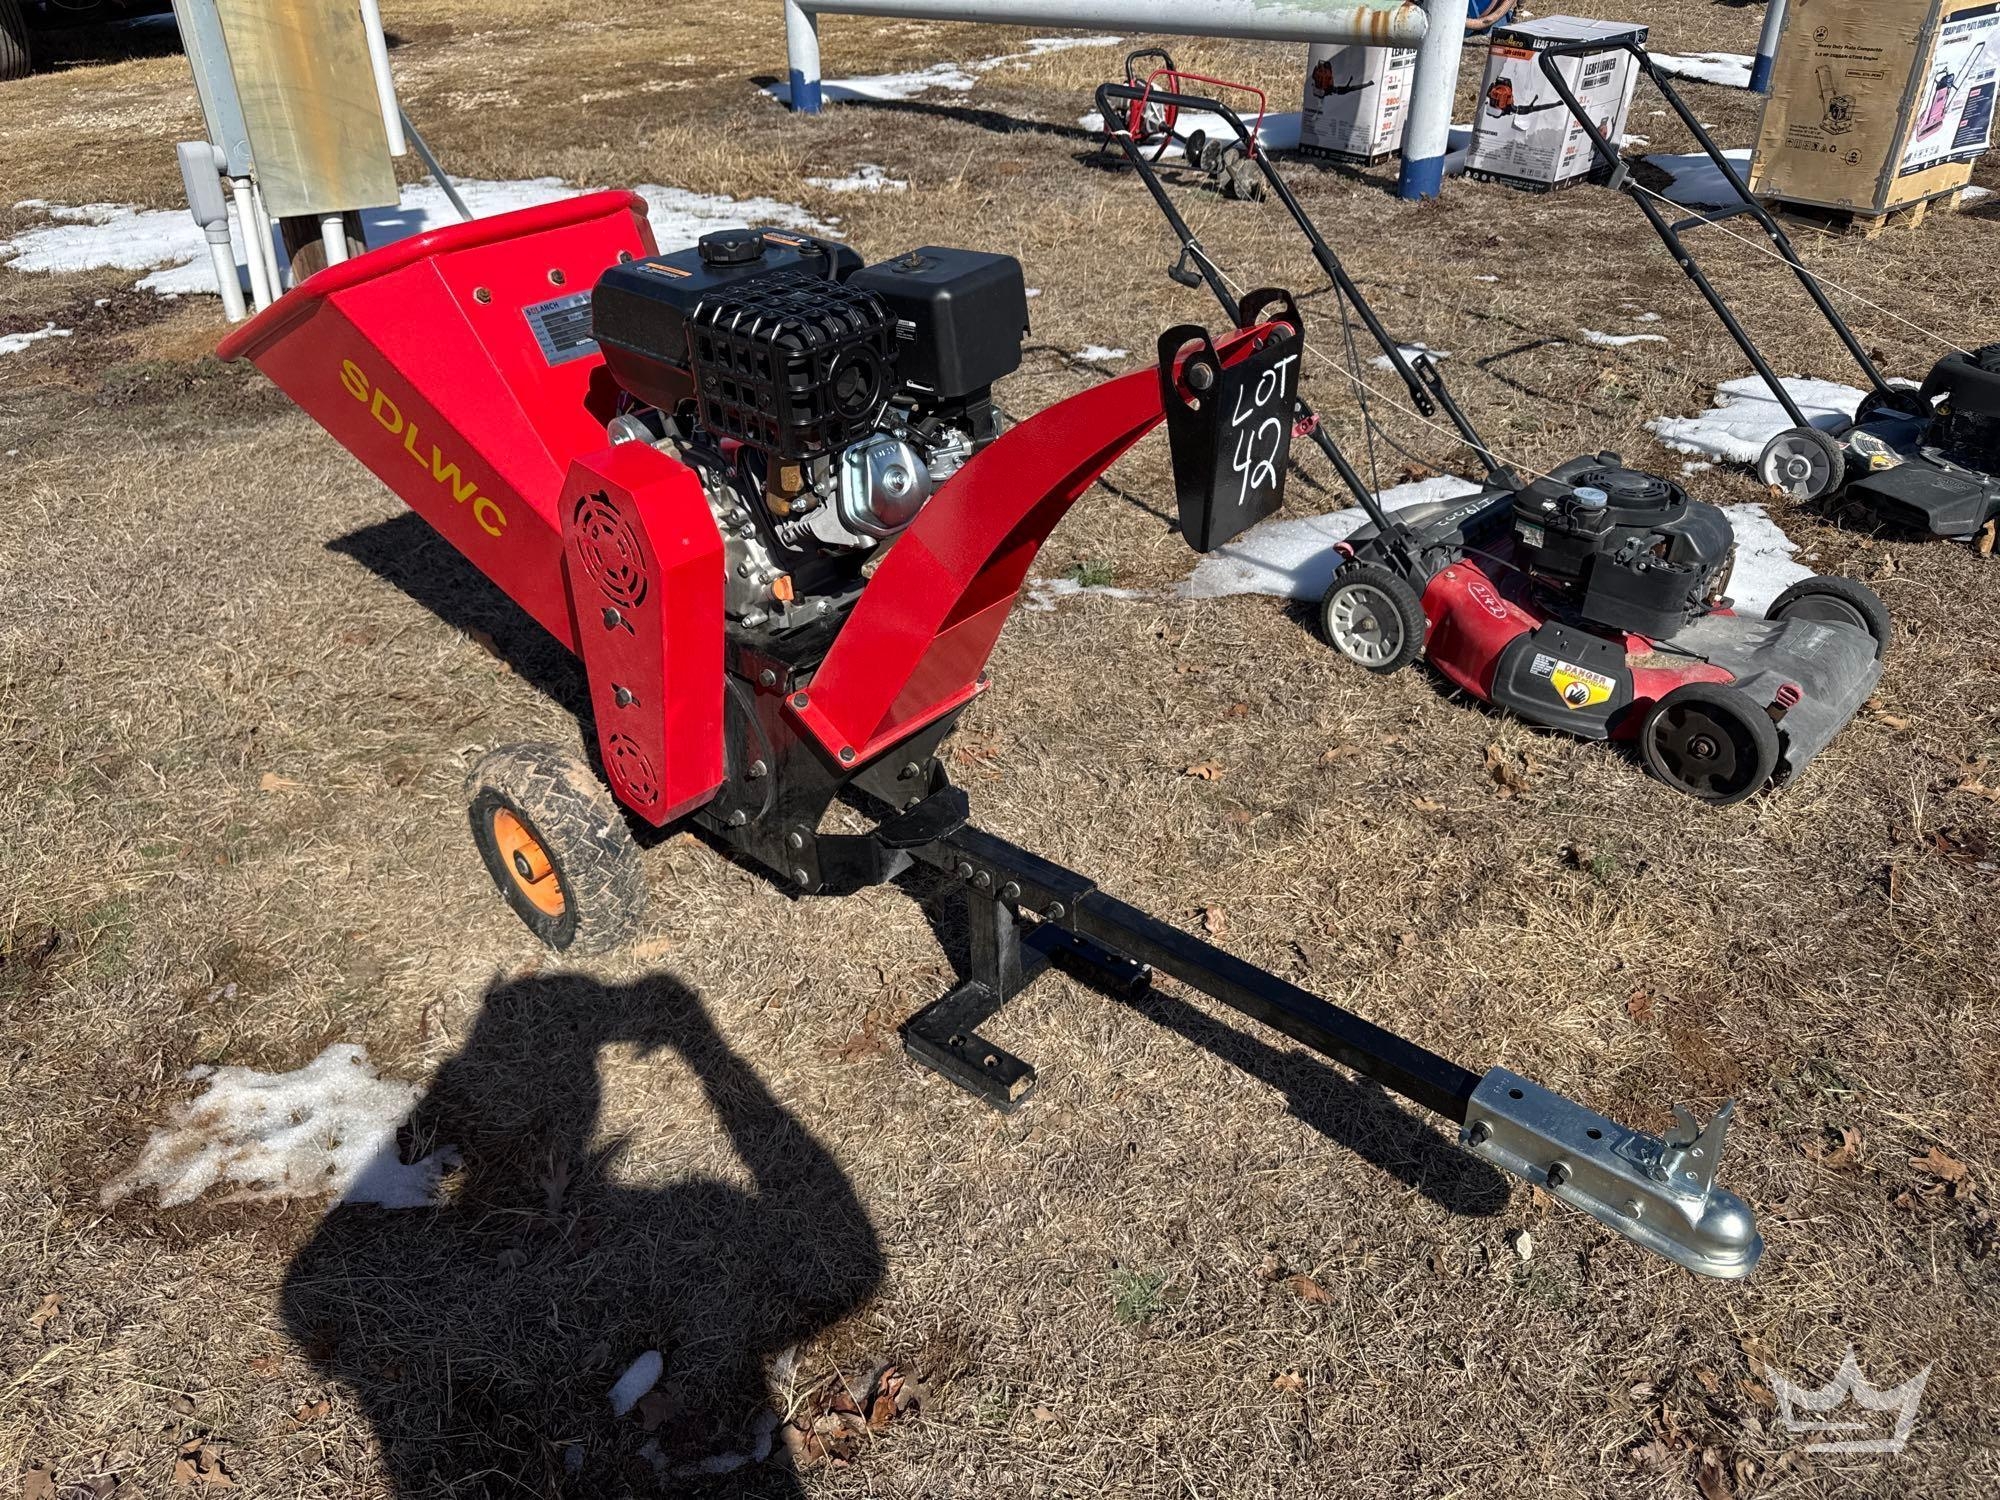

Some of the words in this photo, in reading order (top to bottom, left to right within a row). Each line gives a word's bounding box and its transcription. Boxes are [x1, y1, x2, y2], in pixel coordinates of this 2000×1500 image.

[1533, 38, 1549, 49] LEAF
[1232, 354, 1298, 427] LOT
[338, 358, 507, 538] SDLWC
[1232, 417, 1283, 506] 42
[1563, 663, 1607, 685] DANGER
